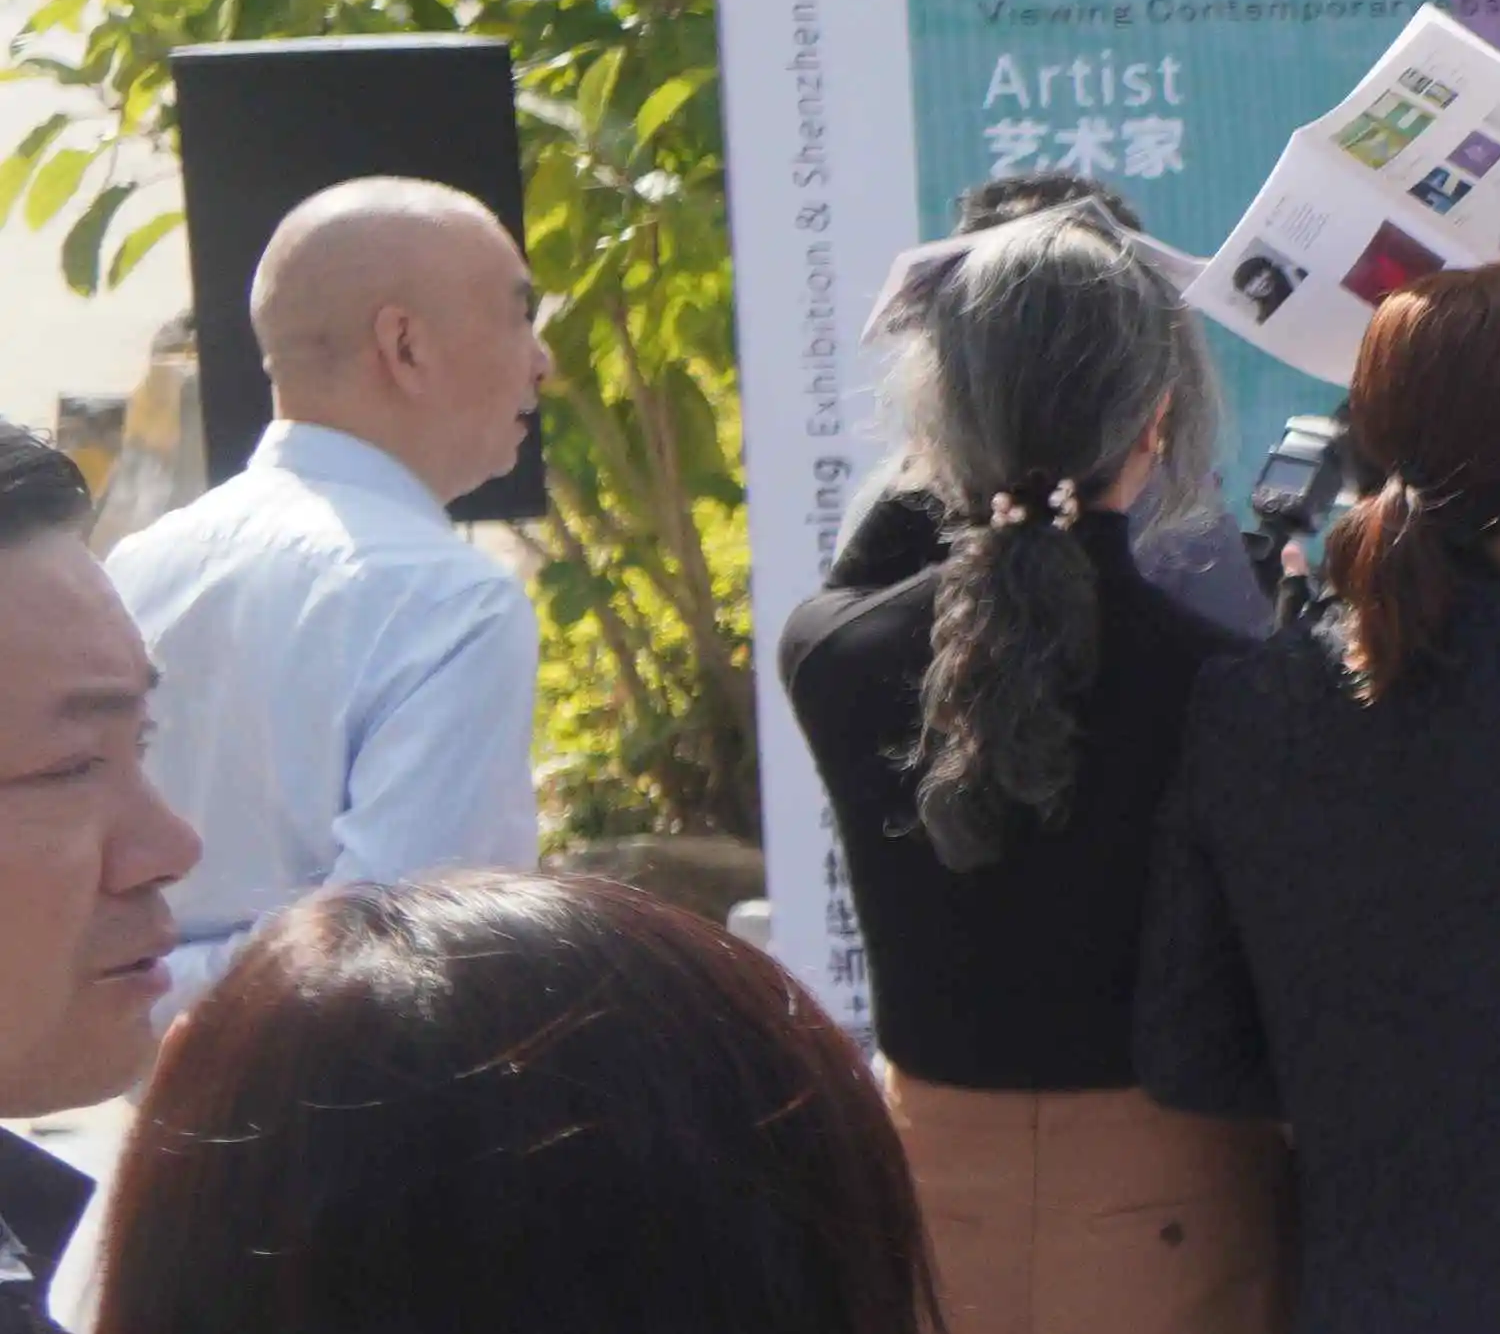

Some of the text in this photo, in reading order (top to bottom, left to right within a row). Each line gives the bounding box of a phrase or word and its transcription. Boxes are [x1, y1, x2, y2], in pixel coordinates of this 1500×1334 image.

[783, 0, 826, 188] Shenzhen
[981, 49, 1186, 111] Artist
[982, 115, 1187, 182] 艺术家
[793, 201, 832, 232] &
[797, 242, 841, 437] Exhibition
